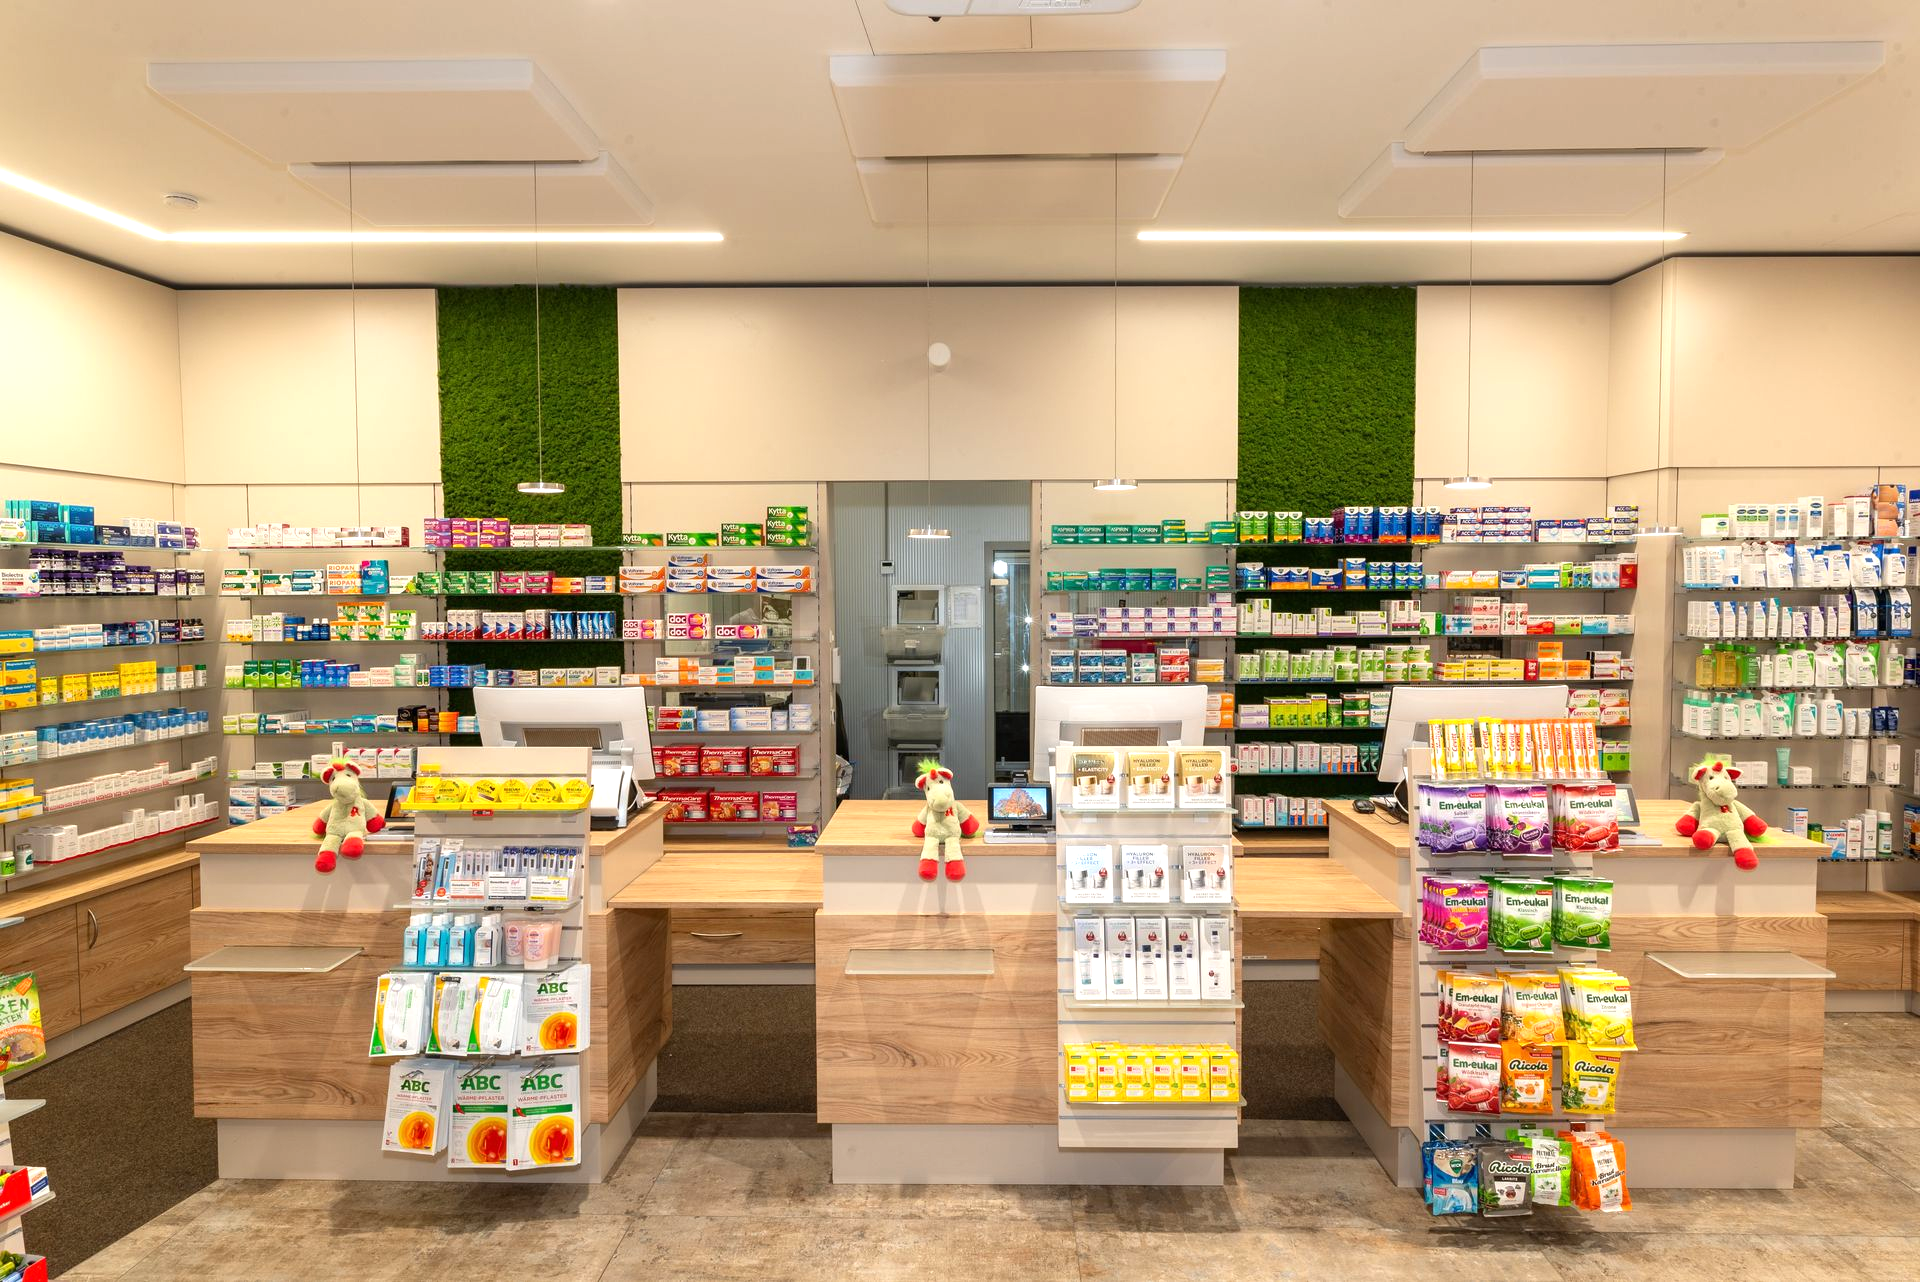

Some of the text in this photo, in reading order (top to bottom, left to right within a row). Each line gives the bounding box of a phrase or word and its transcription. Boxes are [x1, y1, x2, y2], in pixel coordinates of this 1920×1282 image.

[717, 627, 735, 636] doc
[1439, 801, 1481, 810] Em-eukal
[1504, 800, 1545, 810] Em-eukal
[1570, 800, 1612, 808] Em-eukal
[1445, 898, 1486, 906] Em-eukal
[1506, 897, 1549, 907] Em-eukal
[1565, 894, 1609, 905] Em-eukal
[537, 982, 568, 994] ABC
[1455, 993, 1498, 1003] Em-eukal
[1516, 992, 1558, 1000] Em-eukal
[1587, 994, 1628, 1003] Em-eukal
[1453, 1059, 1498, 1070] Em-eukal
[1509, 1059, 1548, 1071] Ricola
[1575, 1061, 1614, 1074] Ricola
[400, 1079, 430, 1092] ABC
[460, 1076, 501, 1090] ABC
[520, 1074, 563, 1091] ABC
[518, 1094, 568, 1102] WÄRME-PFLASTER
[1490, 1161, 1530, 1173] Ricola
